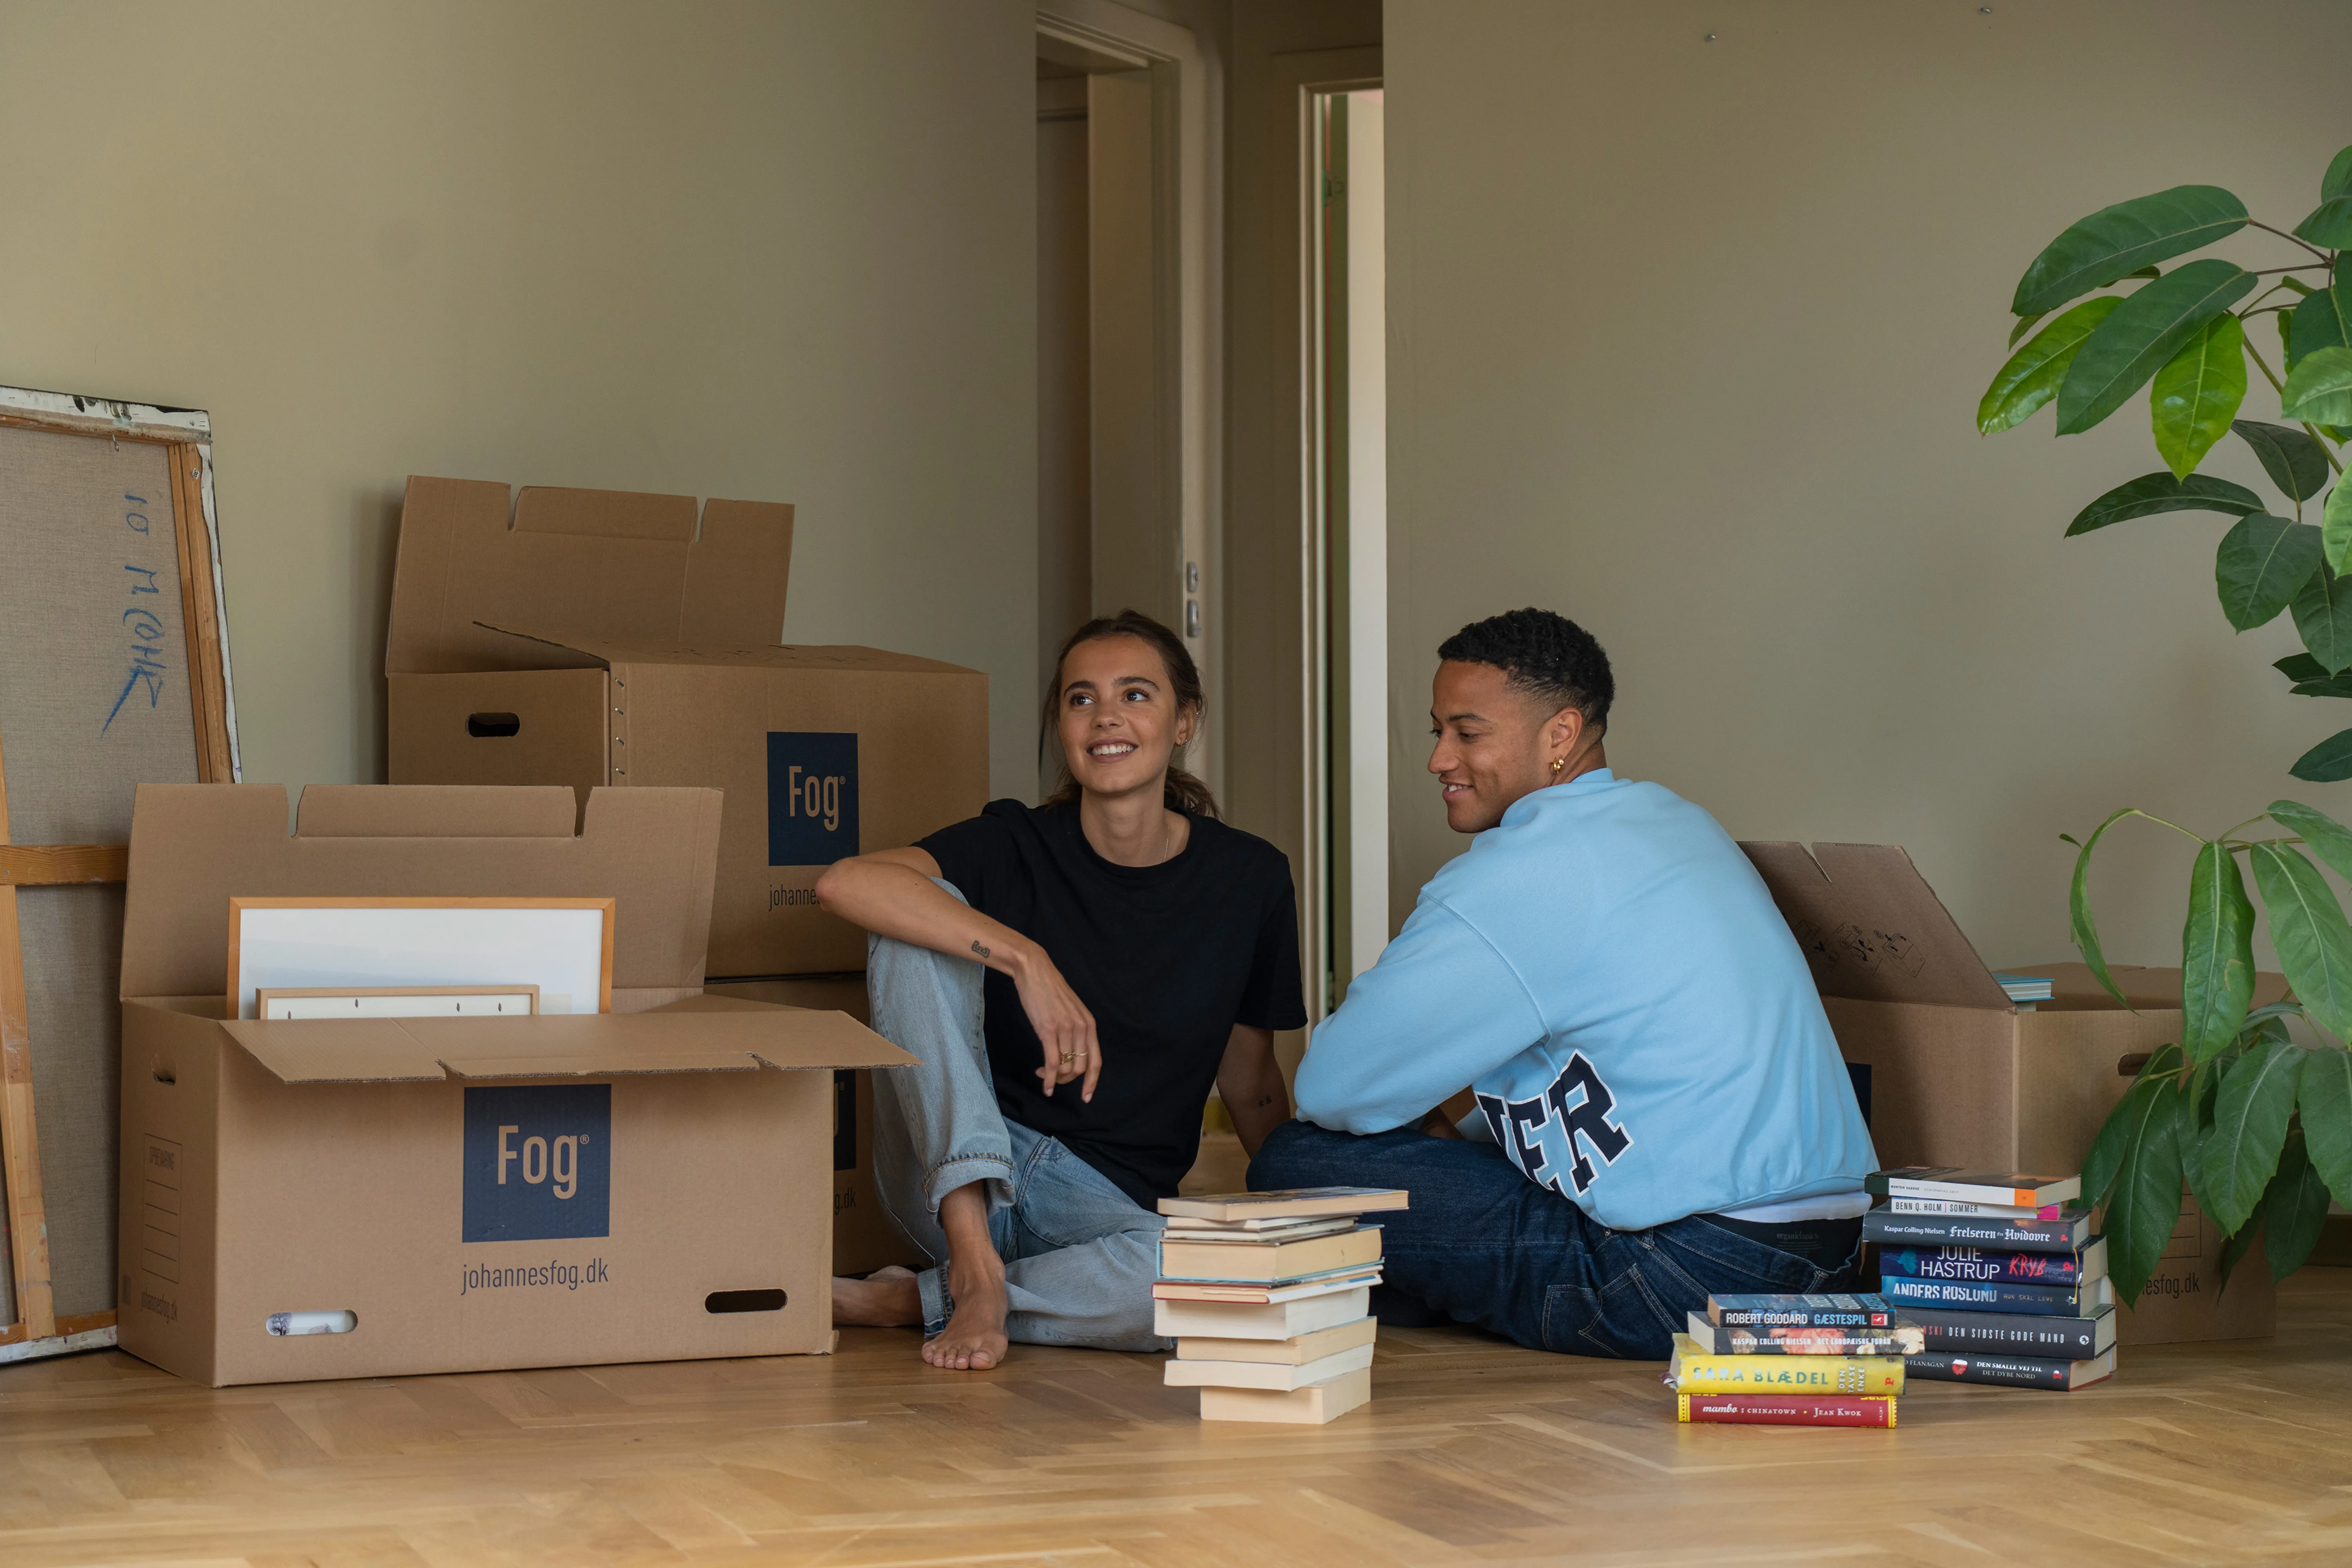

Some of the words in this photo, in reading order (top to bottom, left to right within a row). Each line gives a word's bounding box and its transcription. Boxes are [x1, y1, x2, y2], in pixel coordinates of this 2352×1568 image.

[769, 884, 820, 912] johanne
[1896, 1202, 1913, 1210] BENN
[1915, 1203, 1921, 1211] Q.
[1950, 1204, 1978, 1213] SOMMER
[1949, 1225, 1996, 1239] Frelseren
[1937, 1246, 1983, 1262] JULIE
[1921, 1260, 2000, 1280] HASTRUP
[2009, 1253, 2047, 1277] KRYB
[461, 1258, 609, 1296] johannesfog.dk
[1893, 1283, 1940, 1299] ANDERS
[1942, 1285, 1997, 1302] ROSLUND
[1726, 1312, 1762, 1324] ROBERT
[1764, 1313, 1808, 1324] GODDARD
[1814, 1314, 1867, 1325] GÆSTESPIL
[1871, 1336, 1891, 1345] FORÅR
[1949, 1327, 1965, 1337] DEN
[1971, 1328, 2004, 1340] SIDSTE
[2011, 1331, 2033, 1341] GODE
[2040, 1332, 2064, 1343] MAND
[1693, 1367, 1744, 1381] SARA
[1753, 1369, 1829, 1385] BLÆDEL
[1702, 1403, 1738, 1413] mambo
